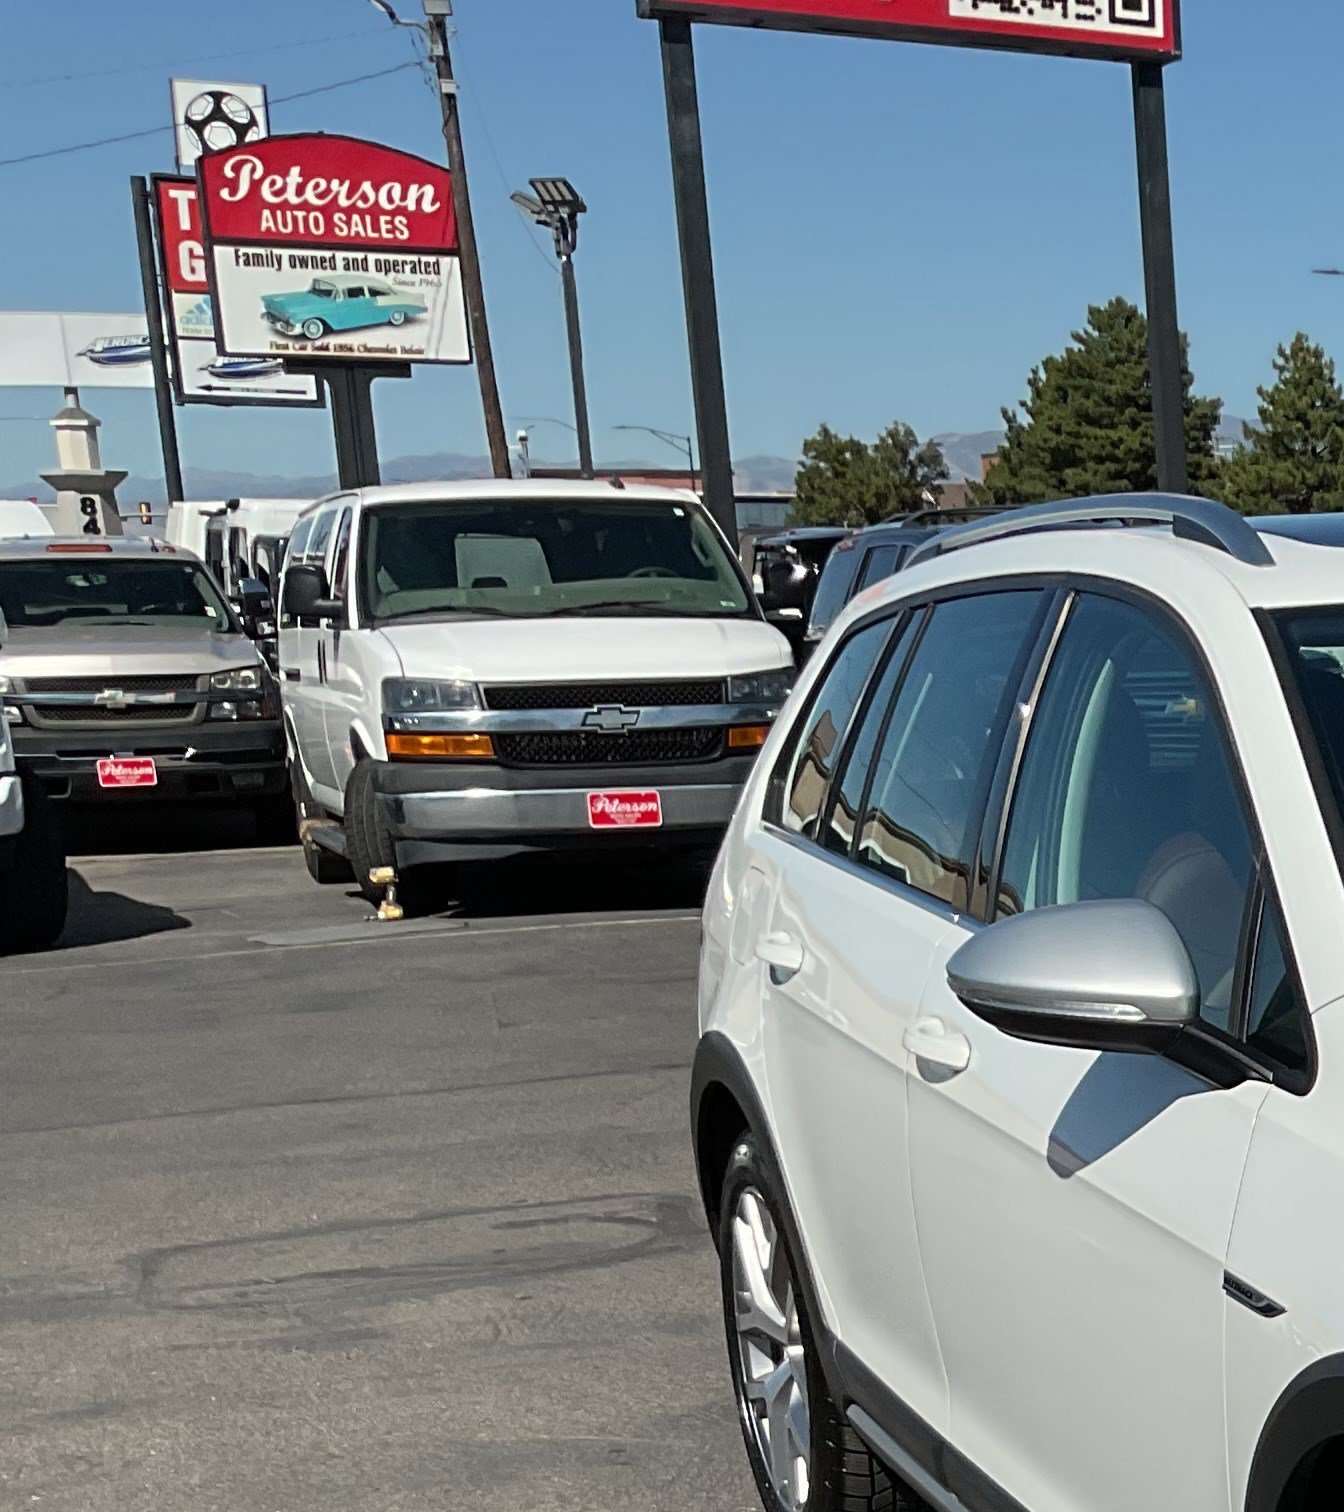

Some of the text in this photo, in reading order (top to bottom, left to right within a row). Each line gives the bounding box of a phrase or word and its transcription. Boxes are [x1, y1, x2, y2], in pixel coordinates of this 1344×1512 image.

[220, 155, 440, 213] Peterson
[261, 209, 409, 240] AUTO SALES
[234, 248, 441, 276] Family owned and operated
